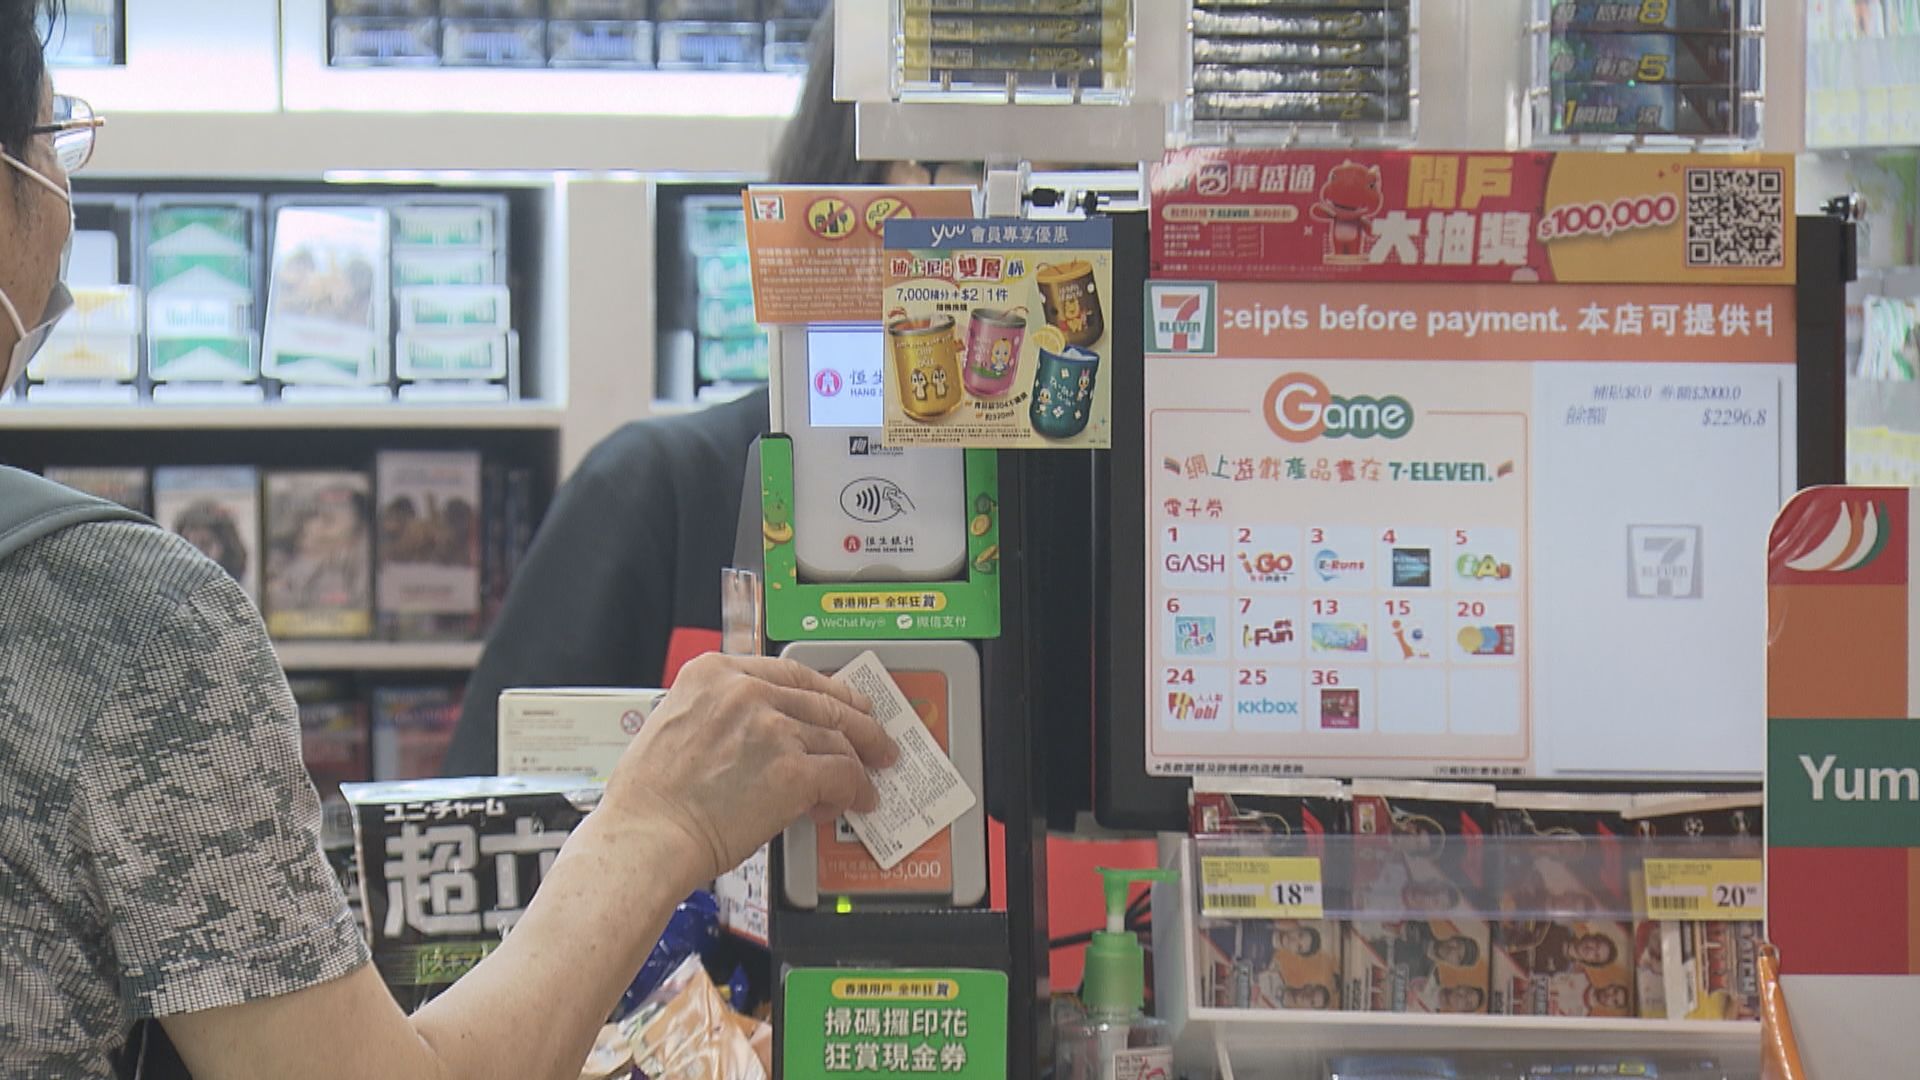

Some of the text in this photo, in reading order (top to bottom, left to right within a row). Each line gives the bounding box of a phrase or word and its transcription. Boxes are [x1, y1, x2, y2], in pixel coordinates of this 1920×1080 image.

[1232, 164, 1316, 193] 華盛通
[1407, 154, 1514, 208] 開戶
[1538, 195, 1679, 242] $100,000
[931, 223, 966, 247] yuu
[971, 225, 1069, 243] 會員專享優惠
[1369, 209, 1531, 266] 大抽獎
[1319, 303, 1418, 331] before
[1427, 305, 1568, 338] payment.
[1275, 382, 1407, 432] Game
[1703, 408, 1768, 427] $2296.8
[1163, 498, 1224, 519] 電子券
[1168, 527, 1178, 543] 1
[1238, 528, 1252, 543] 2
[1310, 528, 1324, 544] 3
[1382, 528, 1396, 544] 4
[1456, 530, 1468, 545] 5
[1165, 553, 1225, 573] GASH
[1167, 598, 1180, 613] 6
[1239, 598, 1251, 614] 7
[1312, 600, 1339, 615] 13
[1385, 600, 1411, 616] 15
[1456, 602, 1485, 617] 20
[1166, 668, 1195, 684] 24
[1239, 669, 1268, 685] 25
[1311, 670, 1339, 686] 36
[1798, 753, 1920, 802] Yum
[384, 797, 506, 823] ユニ・チャーム
[1276, 884, 1303, 906] 18
[1717, 885, 1746, 908] 20
[824, 1006, 968, 1038] 掃碼攞印花
[824, 1042, 968, 1074] 狂賞現金券
